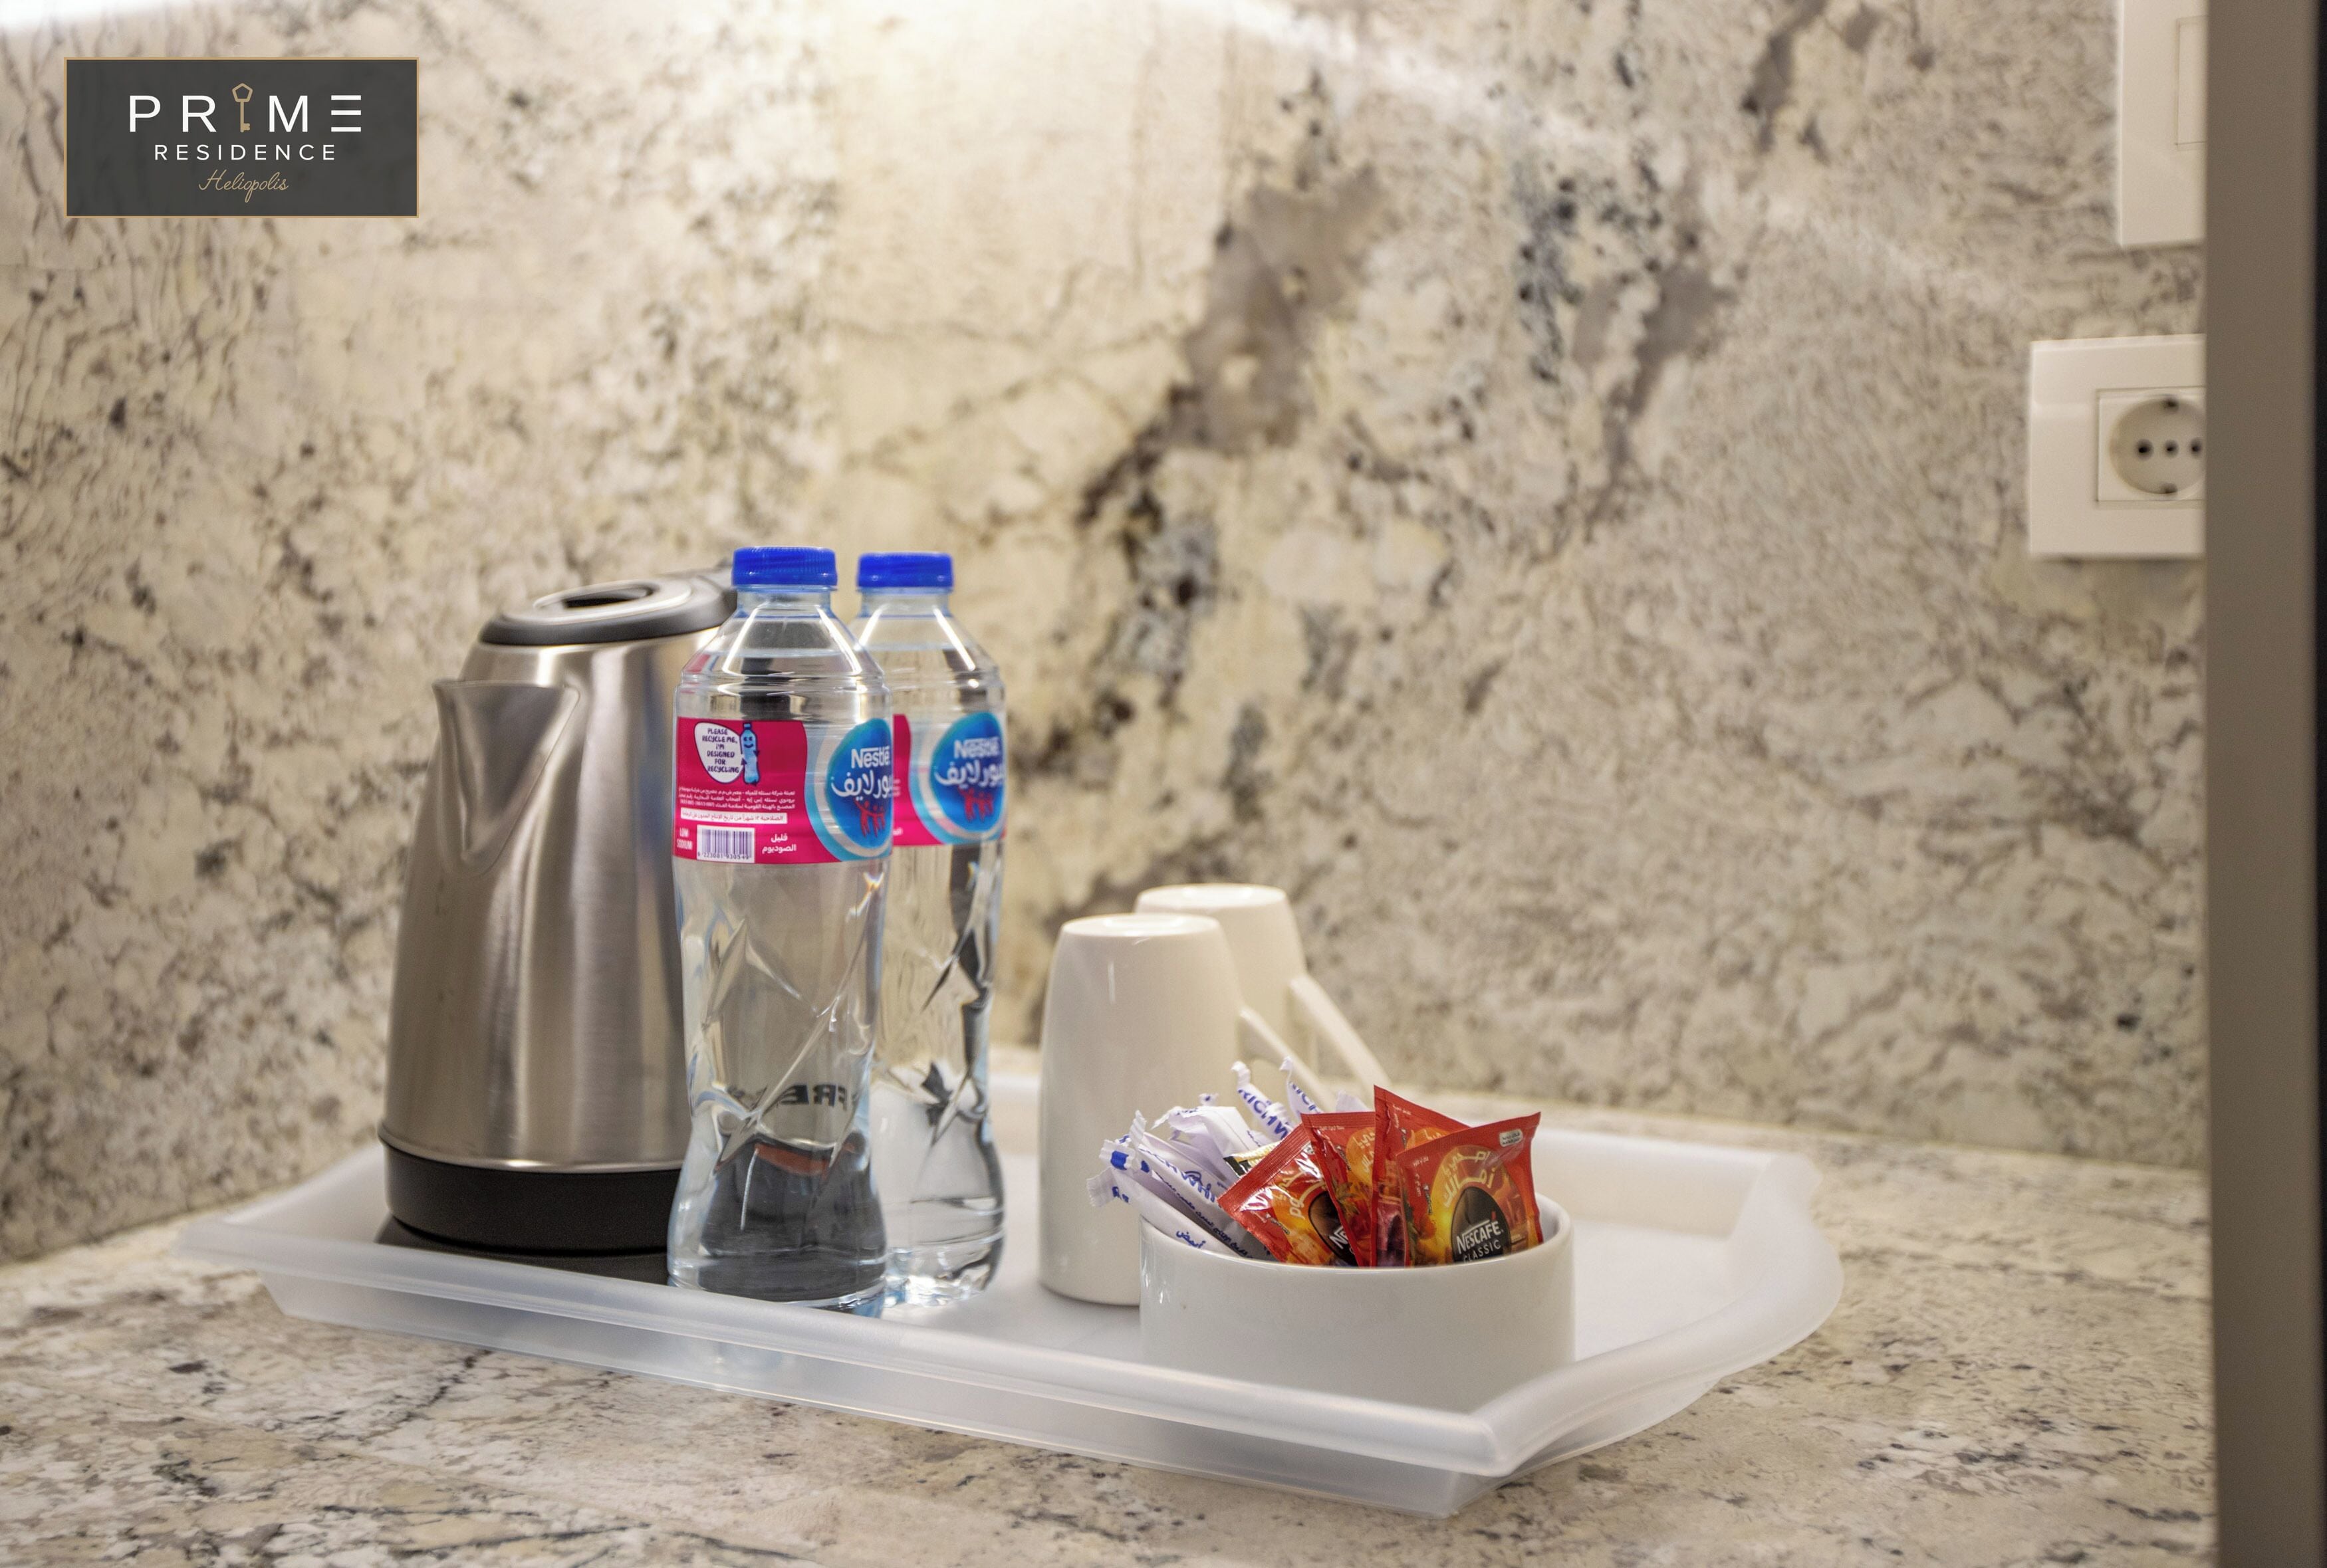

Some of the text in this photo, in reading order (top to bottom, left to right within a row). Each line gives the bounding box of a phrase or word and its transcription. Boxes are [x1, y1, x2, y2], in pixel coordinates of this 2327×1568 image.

[851, 746, 890, 768] Nestlé
[830, 770, 874, 801] لايف
[679, 828, 689, 838] LOW
[771, 833, 788, 843] قليل
[762, 843, 796, 854] الصوديوم
[1463, 1240, 1501, 1262] CLASSIC
